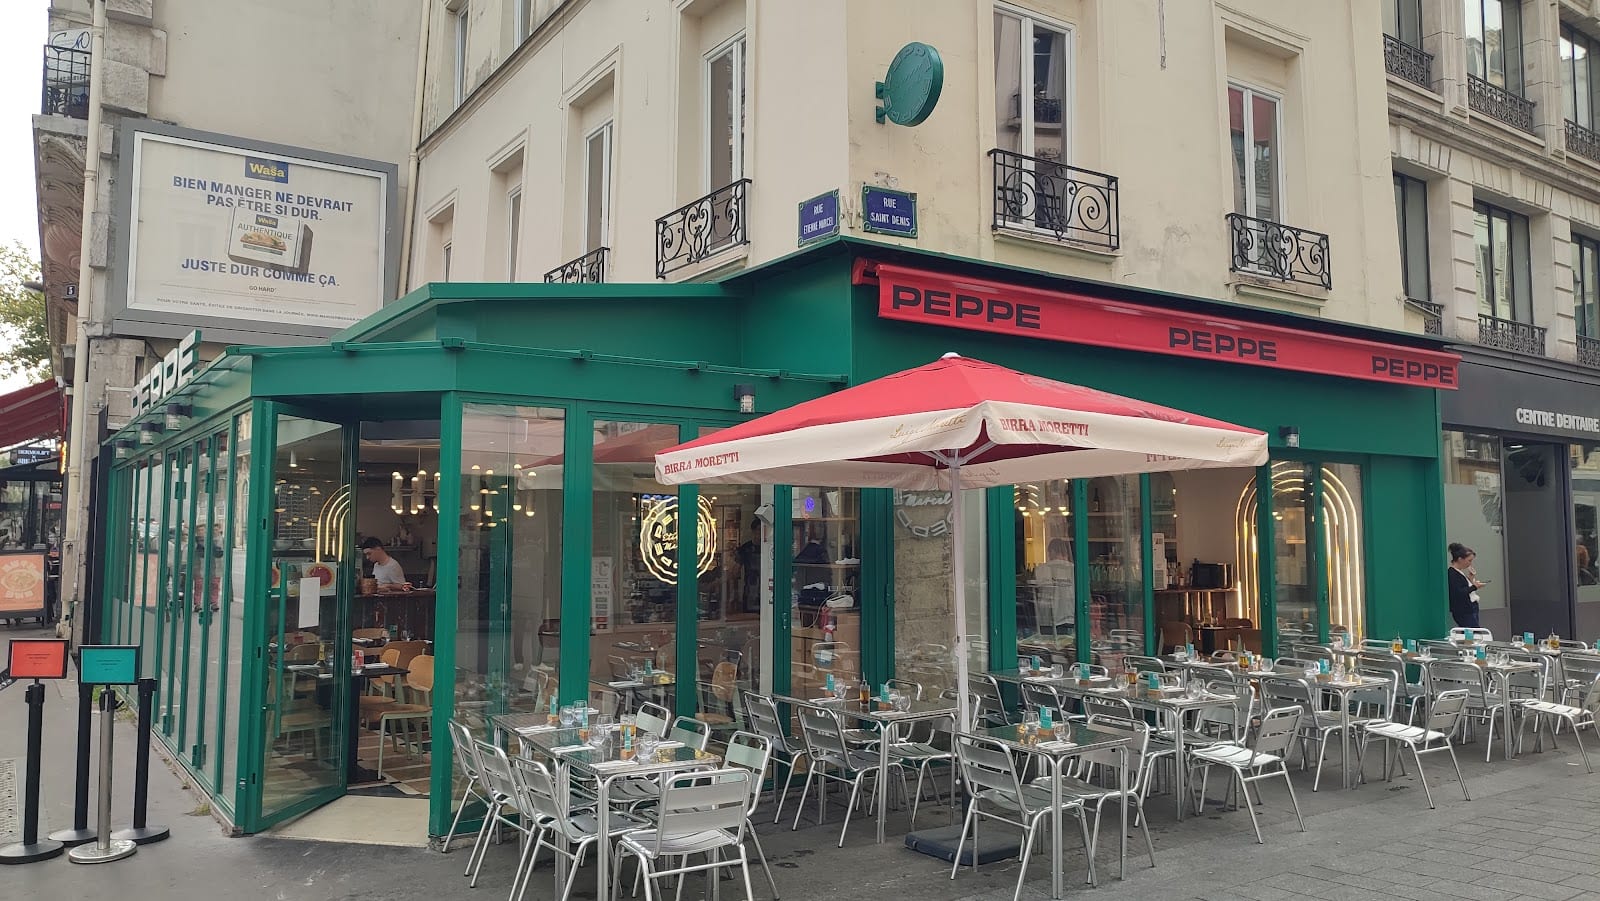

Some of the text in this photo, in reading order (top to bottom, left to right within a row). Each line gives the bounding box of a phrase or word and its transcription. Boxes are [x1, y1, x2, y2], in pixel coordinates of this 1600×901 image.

[173, 175, 353, 213] BIEN MANGER NE DEVRAIT
[883, 197, 897, 209] RUE
[207, 194, 323, 221] PAS ÊTRE SI DUR.
[813, 203, 824, 215] RUE
[870, 212, 911, 227] SAINT DENIS
[237, 222, 293, 241] AUTHENTIQUE
[181, 258, 340, 287] JUSTE DUR COMME ÇA.
[893, 285, 1041, 329] PEPPE
[1169, 327, 1277, 362] PEPPE
[131, 328, 202, 419] PEPPE
[1372, 356, 1454, 384] PEPPE
[1000, 418, 1090, 437] BIRRA MORETTI
[1516, 407, 1600, 433] CENTRE DENTAIRE
[664, 451, 740, 475] BIRRA MORETTI
